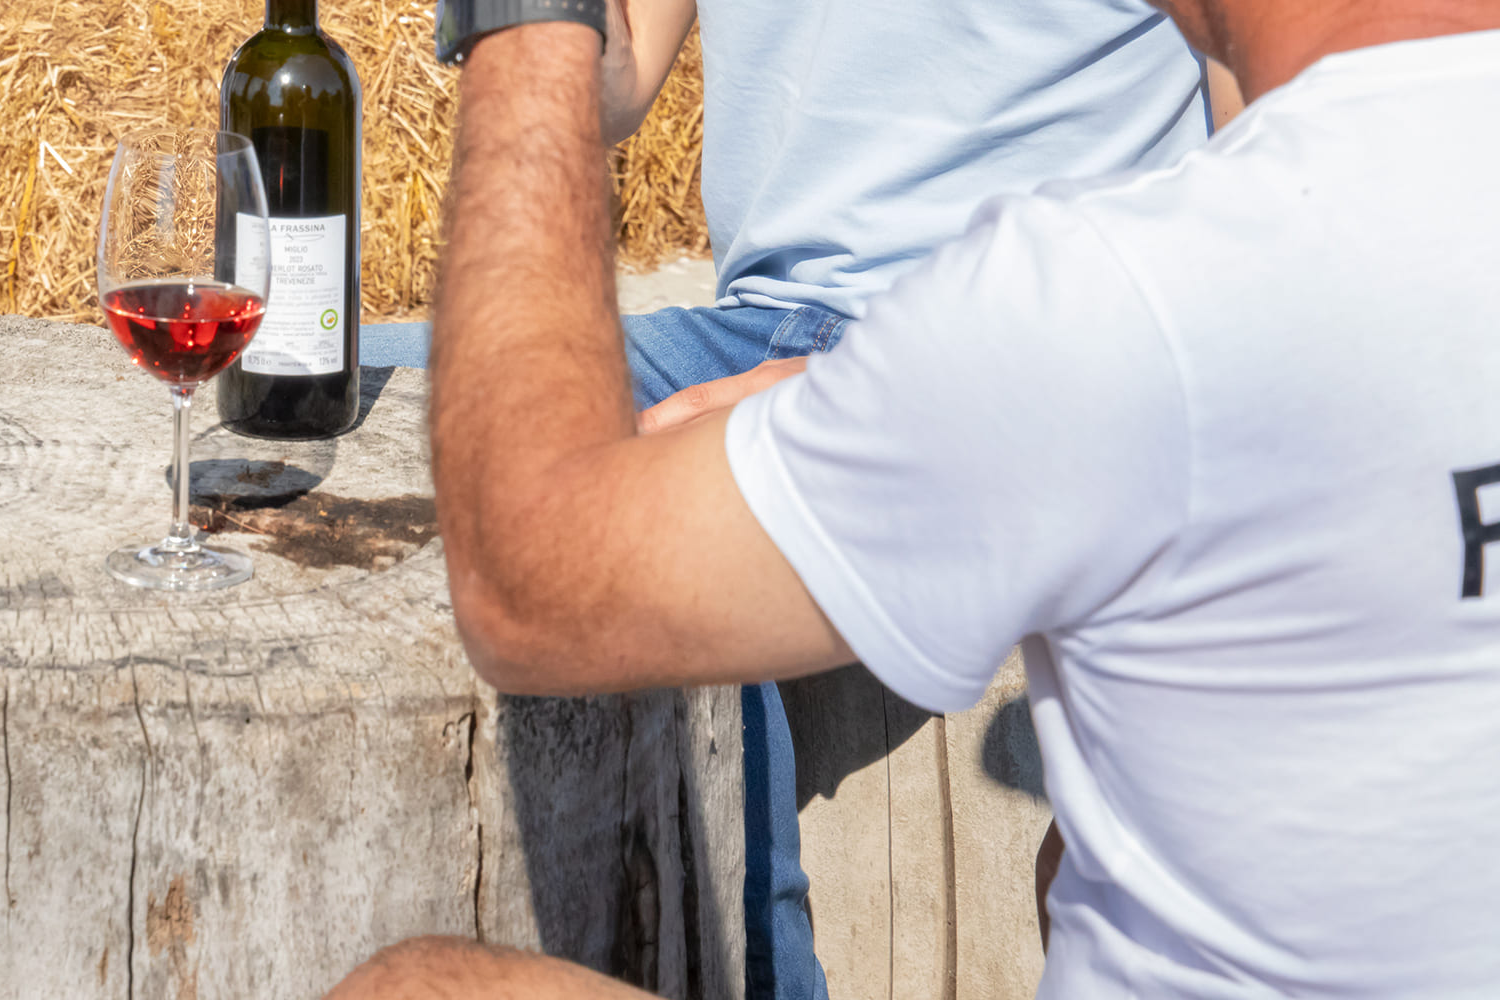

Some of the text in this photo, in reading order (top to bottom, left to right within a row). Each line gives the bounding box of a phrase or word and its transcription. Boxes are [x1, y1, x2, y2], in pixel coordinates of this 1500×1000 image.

[280, 223, 325, 232] FRASSINA
[284, 245, 308, 253] MIGLIO
[297, 264, 323, 272] ROSATO
